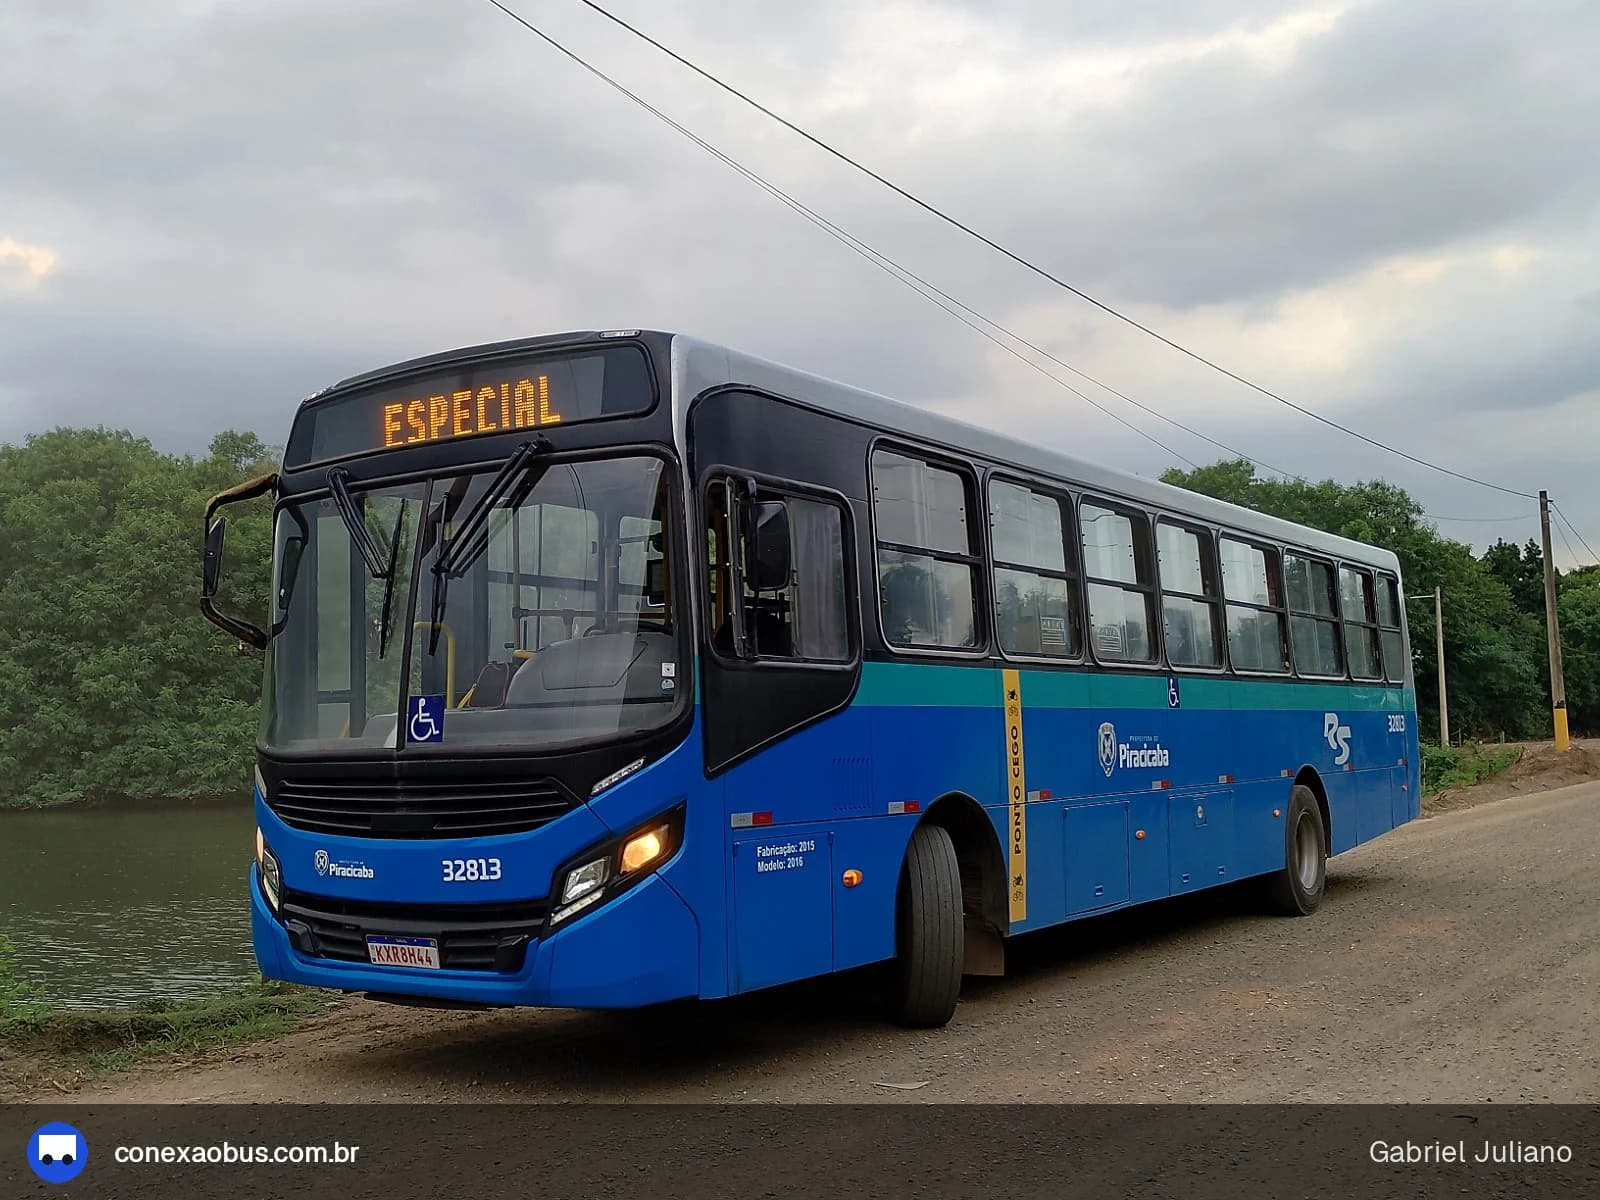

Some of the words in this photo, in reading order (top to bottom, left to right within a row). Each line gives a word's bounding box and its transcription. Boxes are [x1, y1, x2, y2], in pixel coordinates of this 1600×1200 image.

[384, 376, 561, 447] ESPECIAL
[1011, 725, 1019, 778] CEGO
[1119, 743, 1169, 768] Piracicaba
[1013, 785, 1022, 855] PONTO
[757, 843, 798, 857] Fabricação:
[799, 840, 815, 852] 2015
[329, 863, 374, 879] Piracicaba
[442, 858, 502, 881] 32813
[757, 859, 786, 872] Modelo:
[788, 857, 803, 868] 2016
[375, 944, 433, 966] KXR8H44
